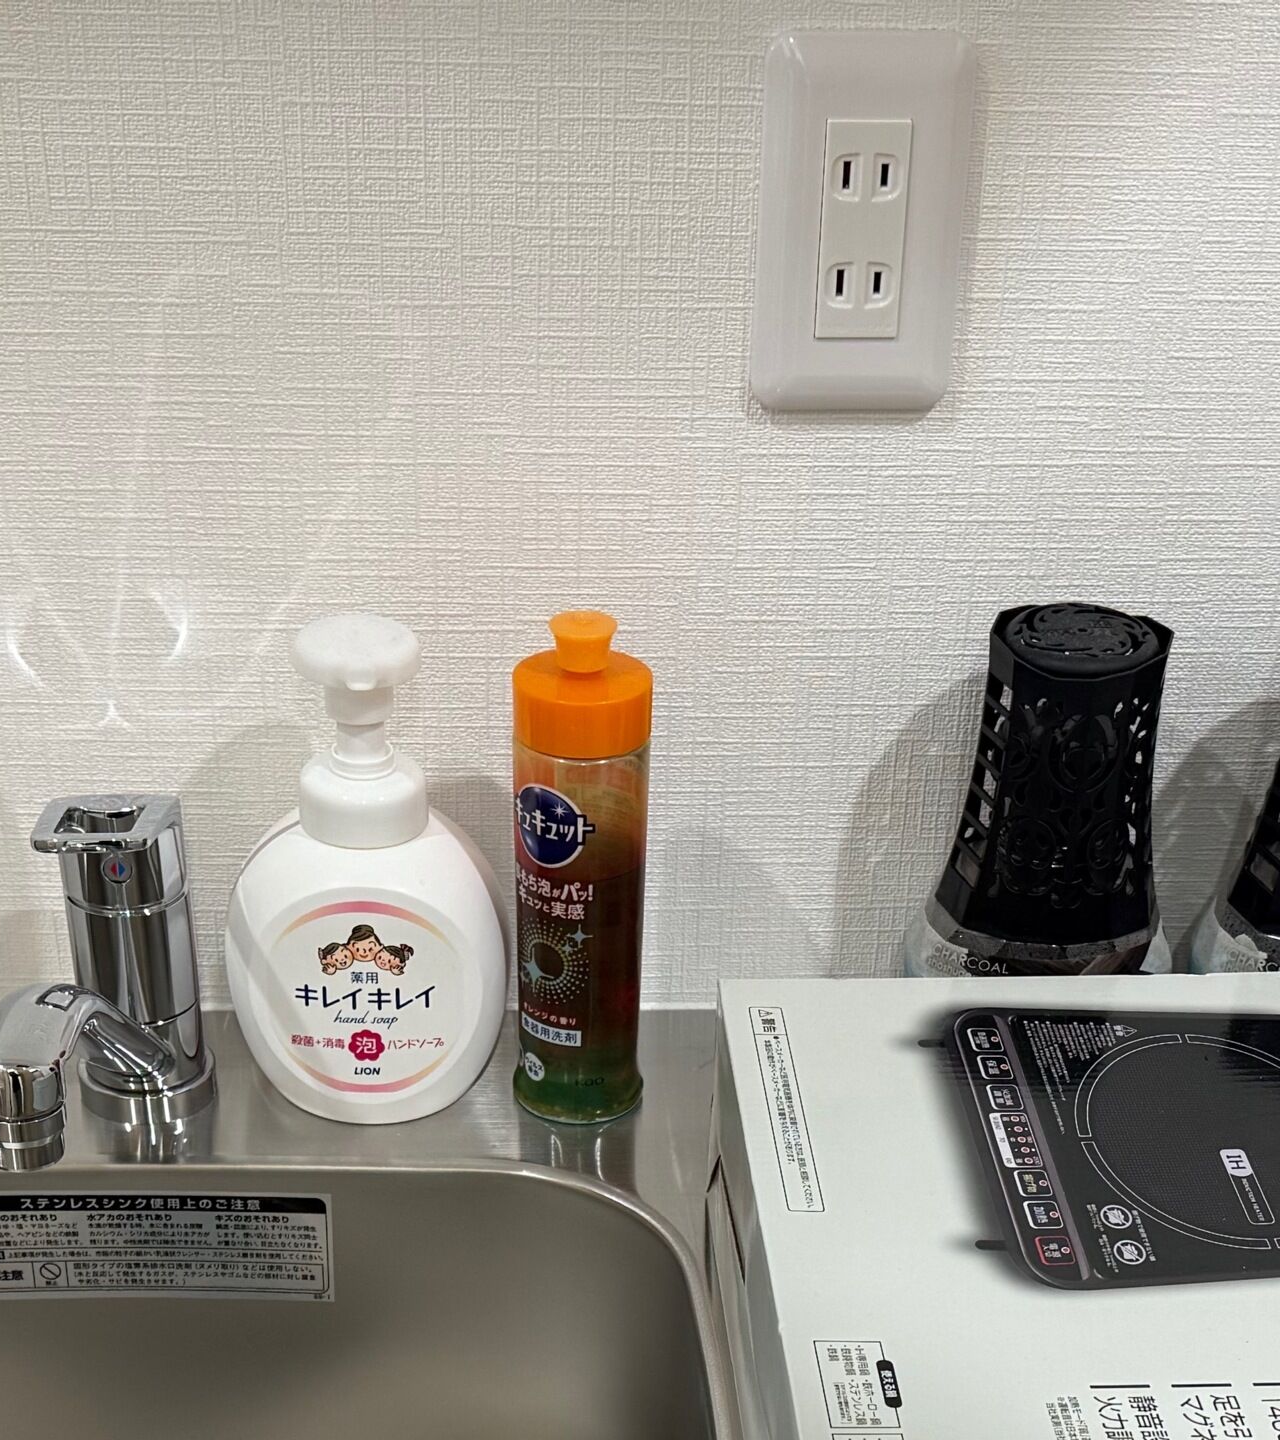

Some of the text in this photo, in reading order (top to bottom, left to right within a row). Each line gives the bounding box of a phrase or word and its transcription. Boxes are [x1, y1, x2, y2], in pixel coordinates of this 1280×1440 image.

[515, 797, 595, 843] キュキュット
[933, 943, 1009, 975] CHARCOAL
[350, 972, 379, 984] 薬用
[295, 984, 436, 1011] キレイキレイ
[333, 1009, 399, 1029] hand soap
[355, 1036, 377, 1054] 泡
[387, 1036, 445, 1050] ハンドソープ
[354, 1067, 381, 1076] LION
[1225, 1154, 1247, 1170] IH
[20, 1197, 261, 1211] ステンレスシンク使用上のご注意
[86, 1213, 173, 1222] 水アカのおそれあり
[215, 1214, 290, 1224] キズのおそれあり
